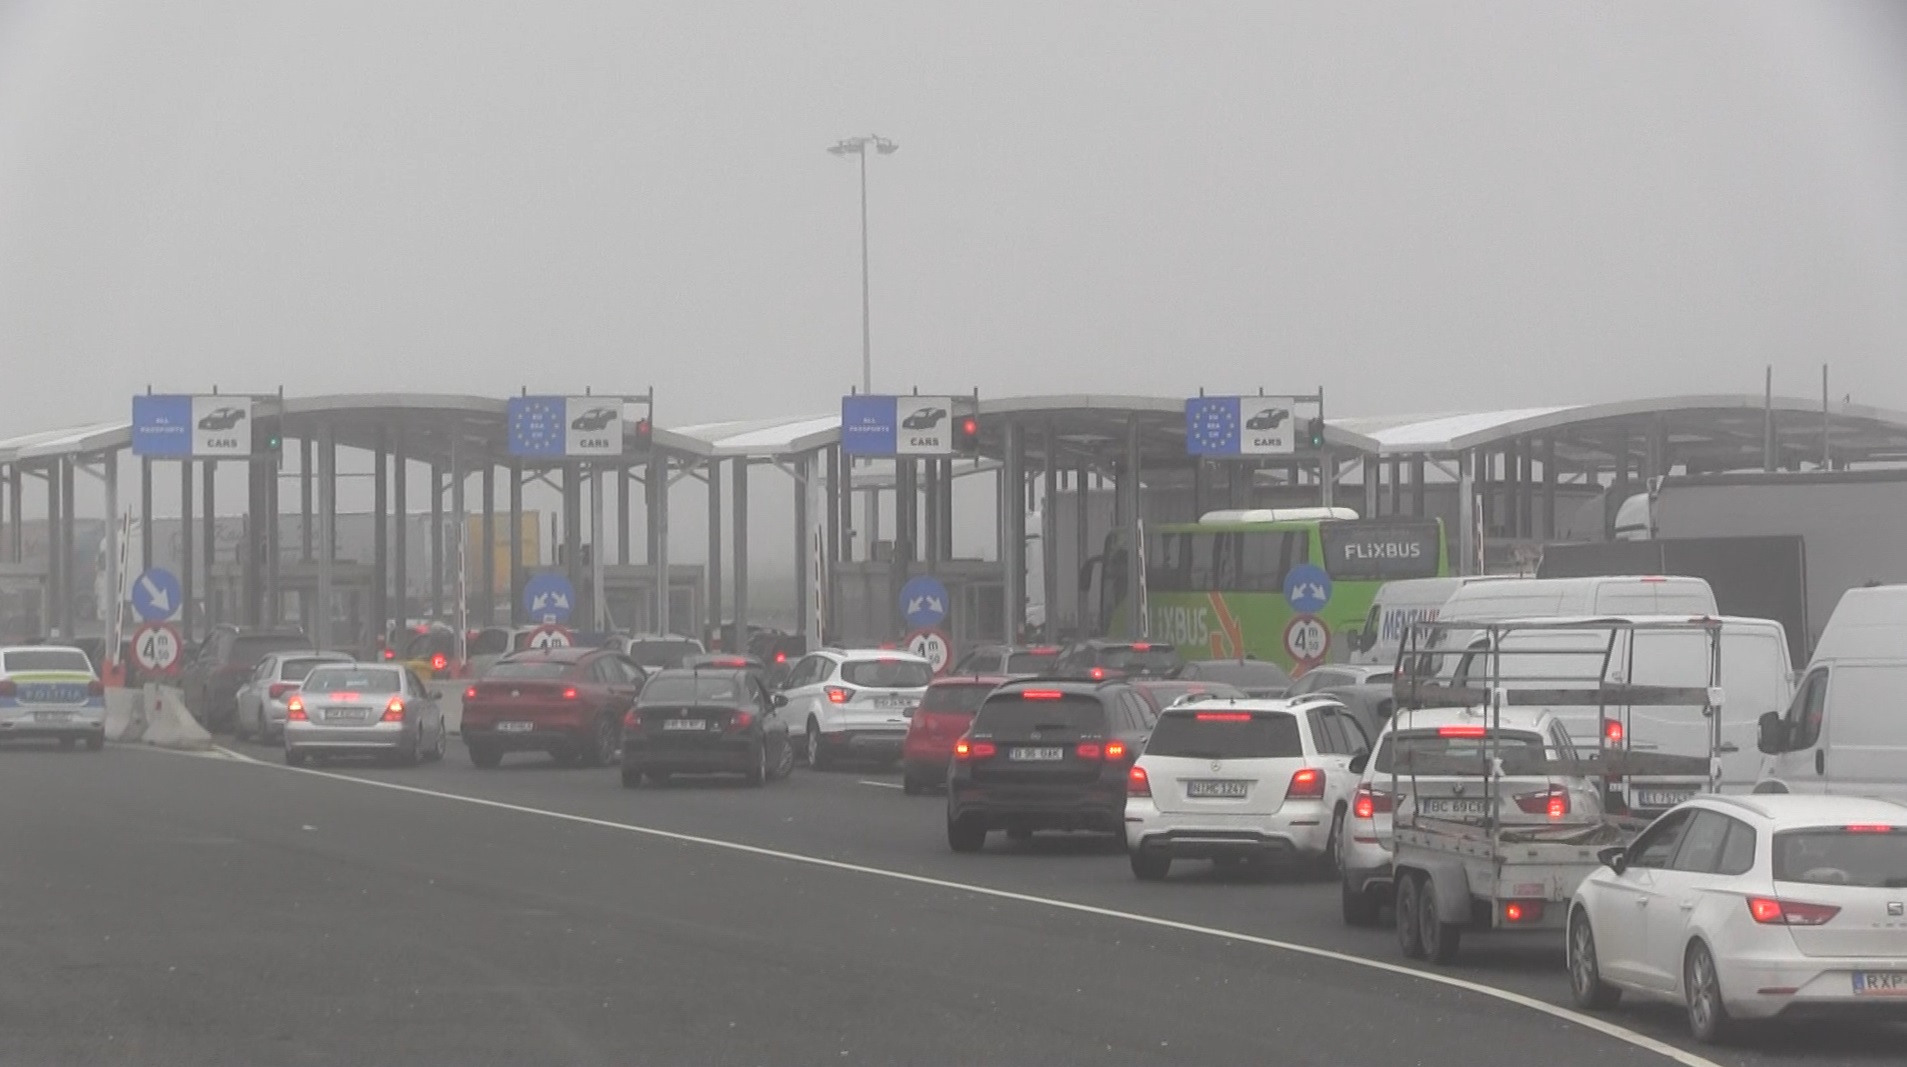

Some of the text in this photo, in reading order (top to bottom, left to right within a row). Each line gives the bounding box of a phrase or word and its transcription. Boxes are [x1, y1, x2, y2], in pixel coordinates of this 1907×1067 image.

[139, 426, 185, 434] PASSPORTS
[207, 438, 238, 448] CARS
[580, 439, 609, 448] CARS
[910, 437, 939, 446] CARS
[1254, 438, 1282, 447] CARS
[1294, 627, 1306, 650] 4
[143, 635, 155, 660] 4
[1431, 800, 1449, 812] BC
